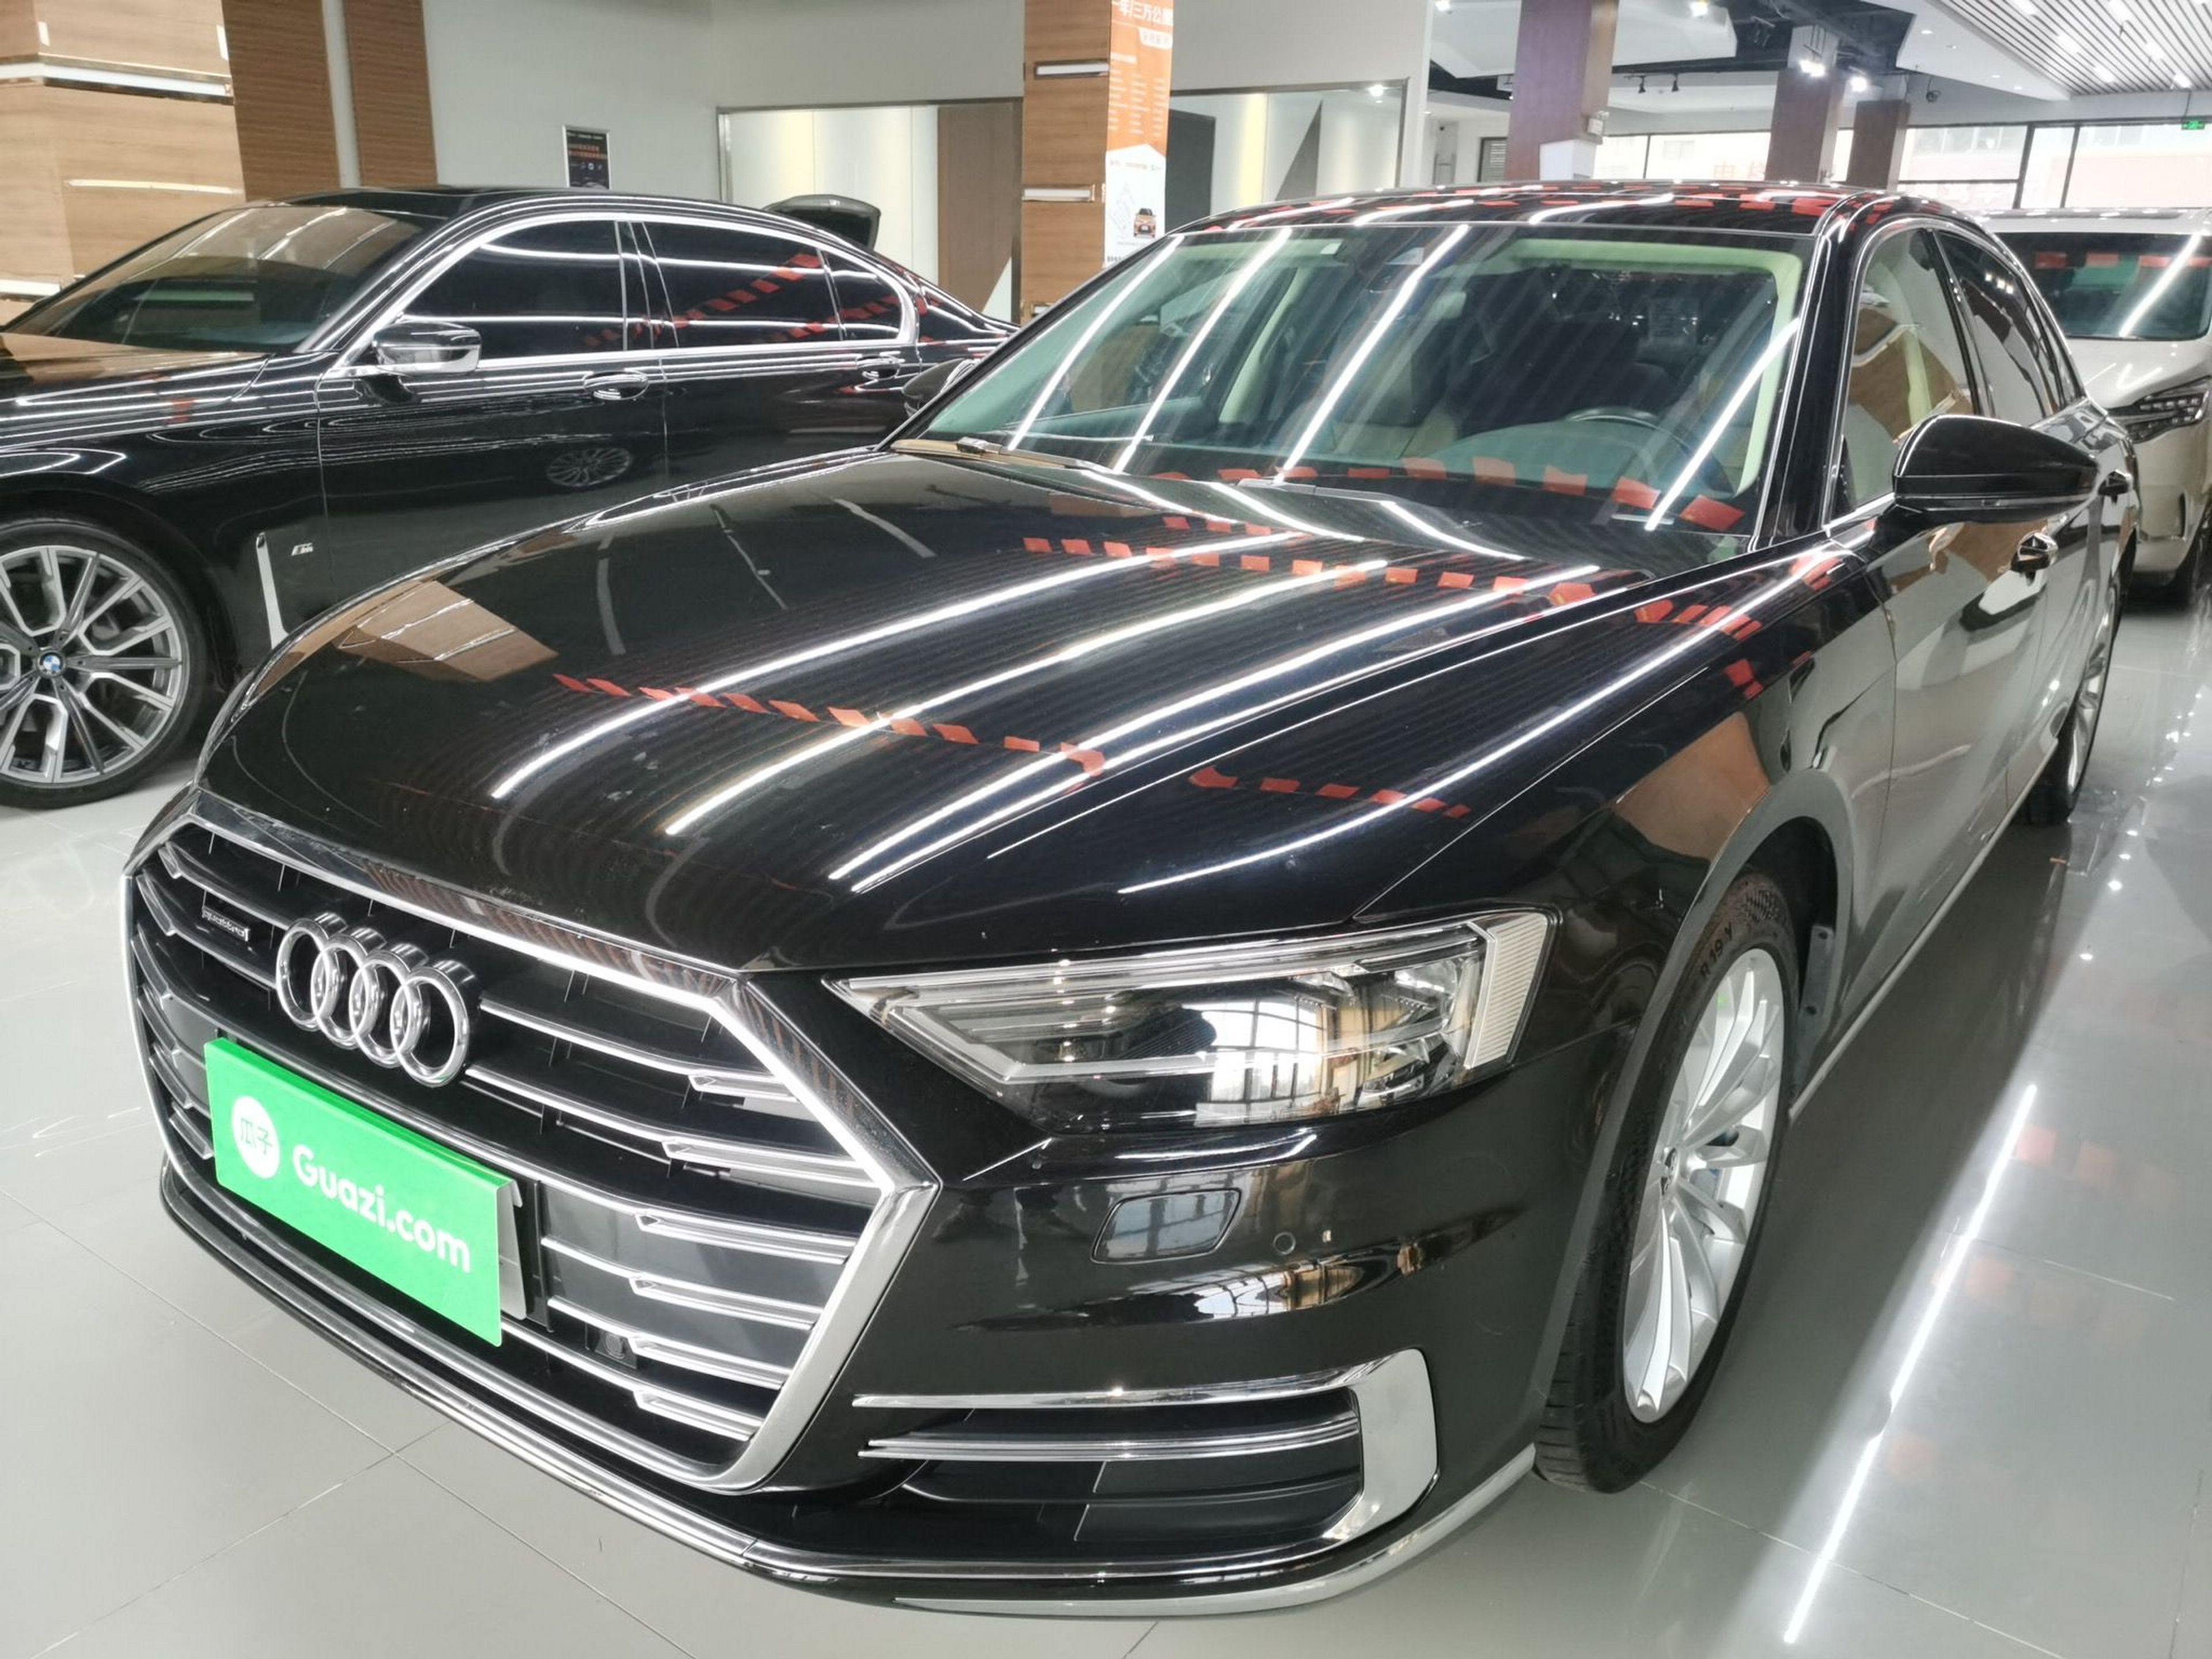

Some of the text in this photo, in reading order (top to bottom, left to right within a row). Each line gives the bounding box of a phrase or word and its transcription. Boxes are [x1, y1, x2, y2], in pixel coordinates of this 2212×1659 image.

[1709, 939, 1724, 963] 19
[240, 1117, 273, 1156] 瓜子
[293, 1144, 471, 1273] Guazi.com
